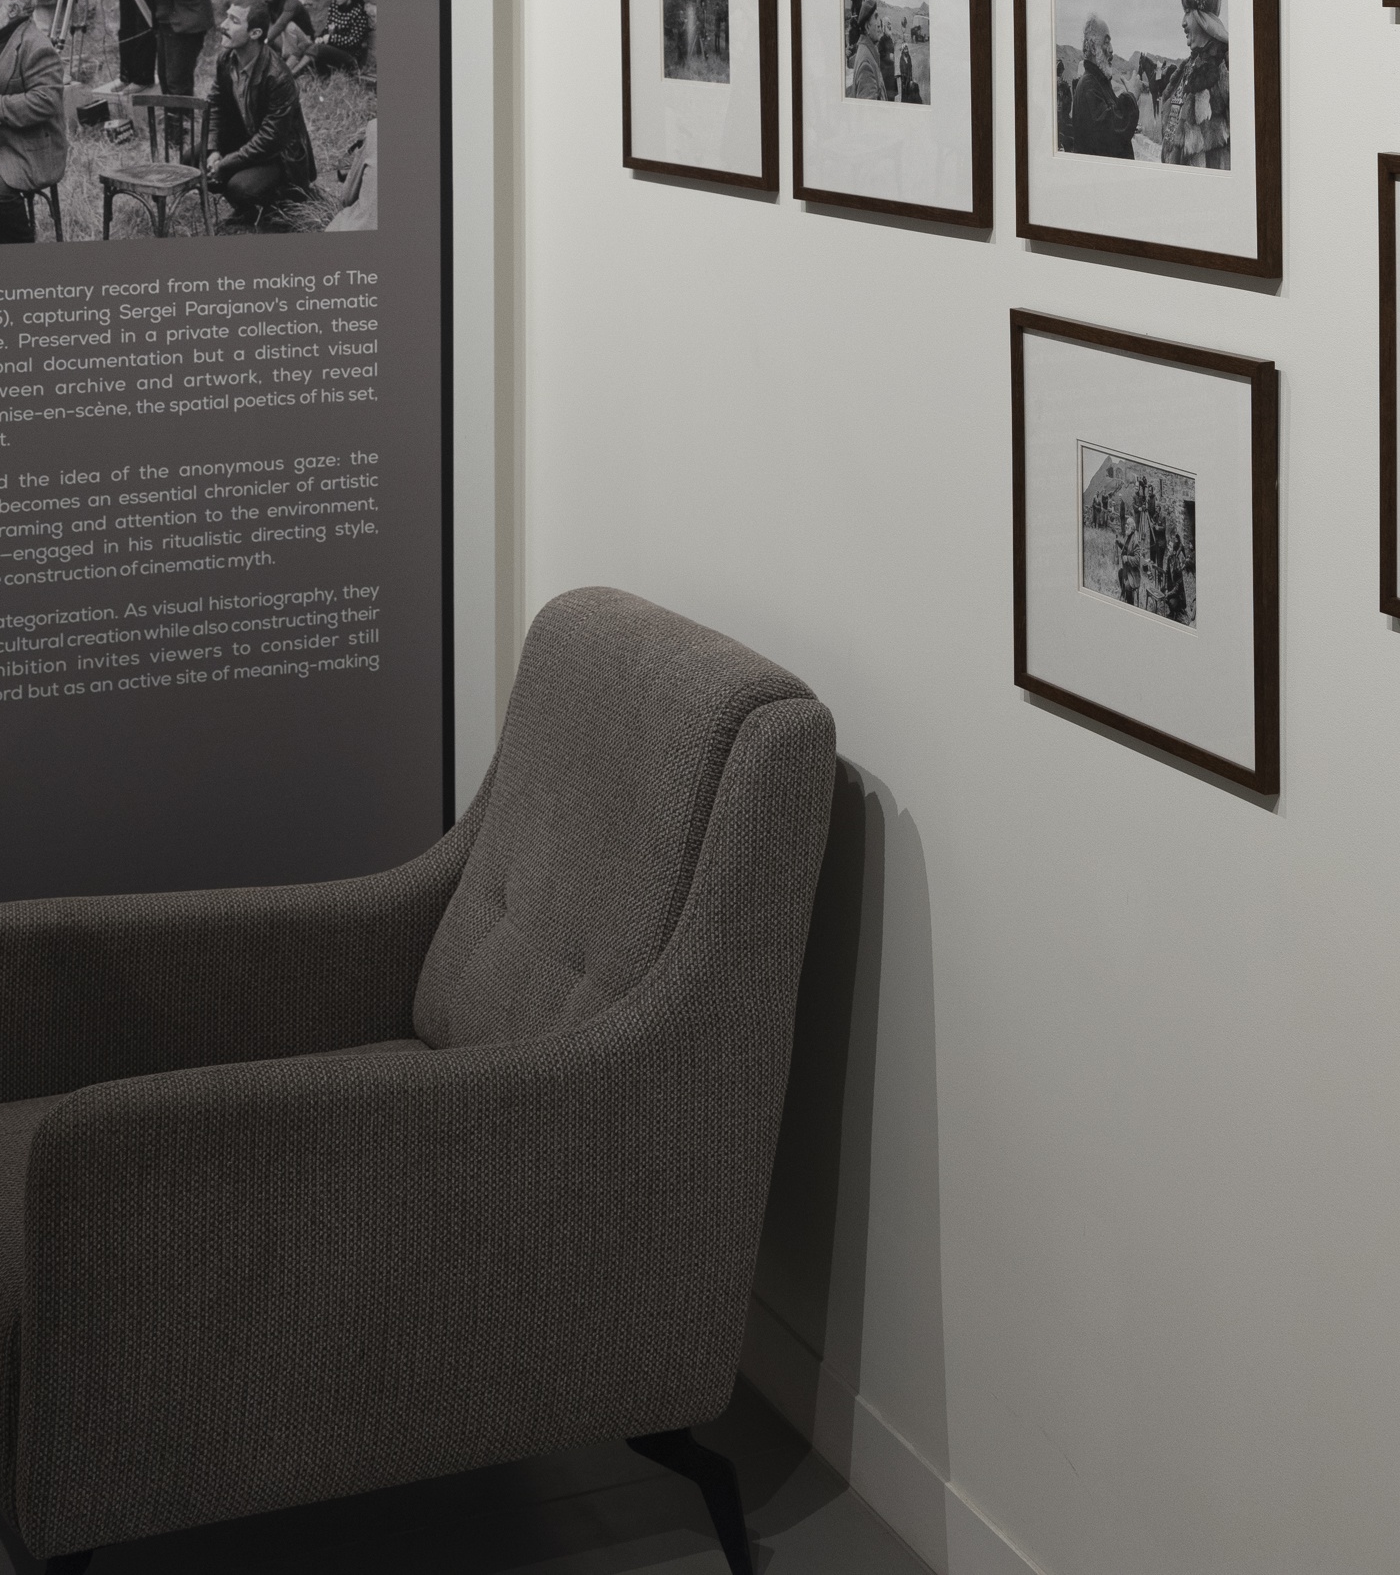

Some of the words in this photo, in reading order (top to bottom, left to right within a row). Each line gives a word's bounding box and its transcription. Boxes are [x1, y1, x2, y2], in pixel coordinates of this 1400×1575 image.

[102, 279, 160, 296] record
[167, 278, 209, 293] from
[217, 276, 246, 291] the
[253, 273, 316, 292] making
[323, 271, 341, 286] of
[346, 270, 378, 285] The
[23, 306, 111, 327] capturing
[119, 302, 176, 323] Sergei
[296, 293, 378, 311] cinematic
[19, 329, 111, 348] Preserved
[121, 329, 136, 343] in
[145, 331, 157, 342] a
[166, 325, 229, 345] private
[238, 320, 322, 337] collection,
[331, 318, 378, 332] these
[43, 350, 183, 371] documentation
[193, 349, 224, 363] but
[233, 350, 245, 361] a
[255, 344, 319, 360] distinct
[328, 339, 378, 355] visual
[55, 378, 126, 395] archive
[136, 374, 173, 390] and
[183, 369, 262, 387] artwork,
[272, 368, 312, 385] they
[322, 362, 378, 379] reveal
[136, 399, 165, 414] the
[170, 394, 229, 416] spatial
[234, 391, 296, 412] poetics
[300, 389, 317, 404] of
[321, 388, 344, 403] his
[348, 387, 378, 401] set,
[124, 603, 147, 618] As
[152, 597, 203, 615] visual
[209, 588, 337, 610] historiography,
[343, 585, 379, 601] they
